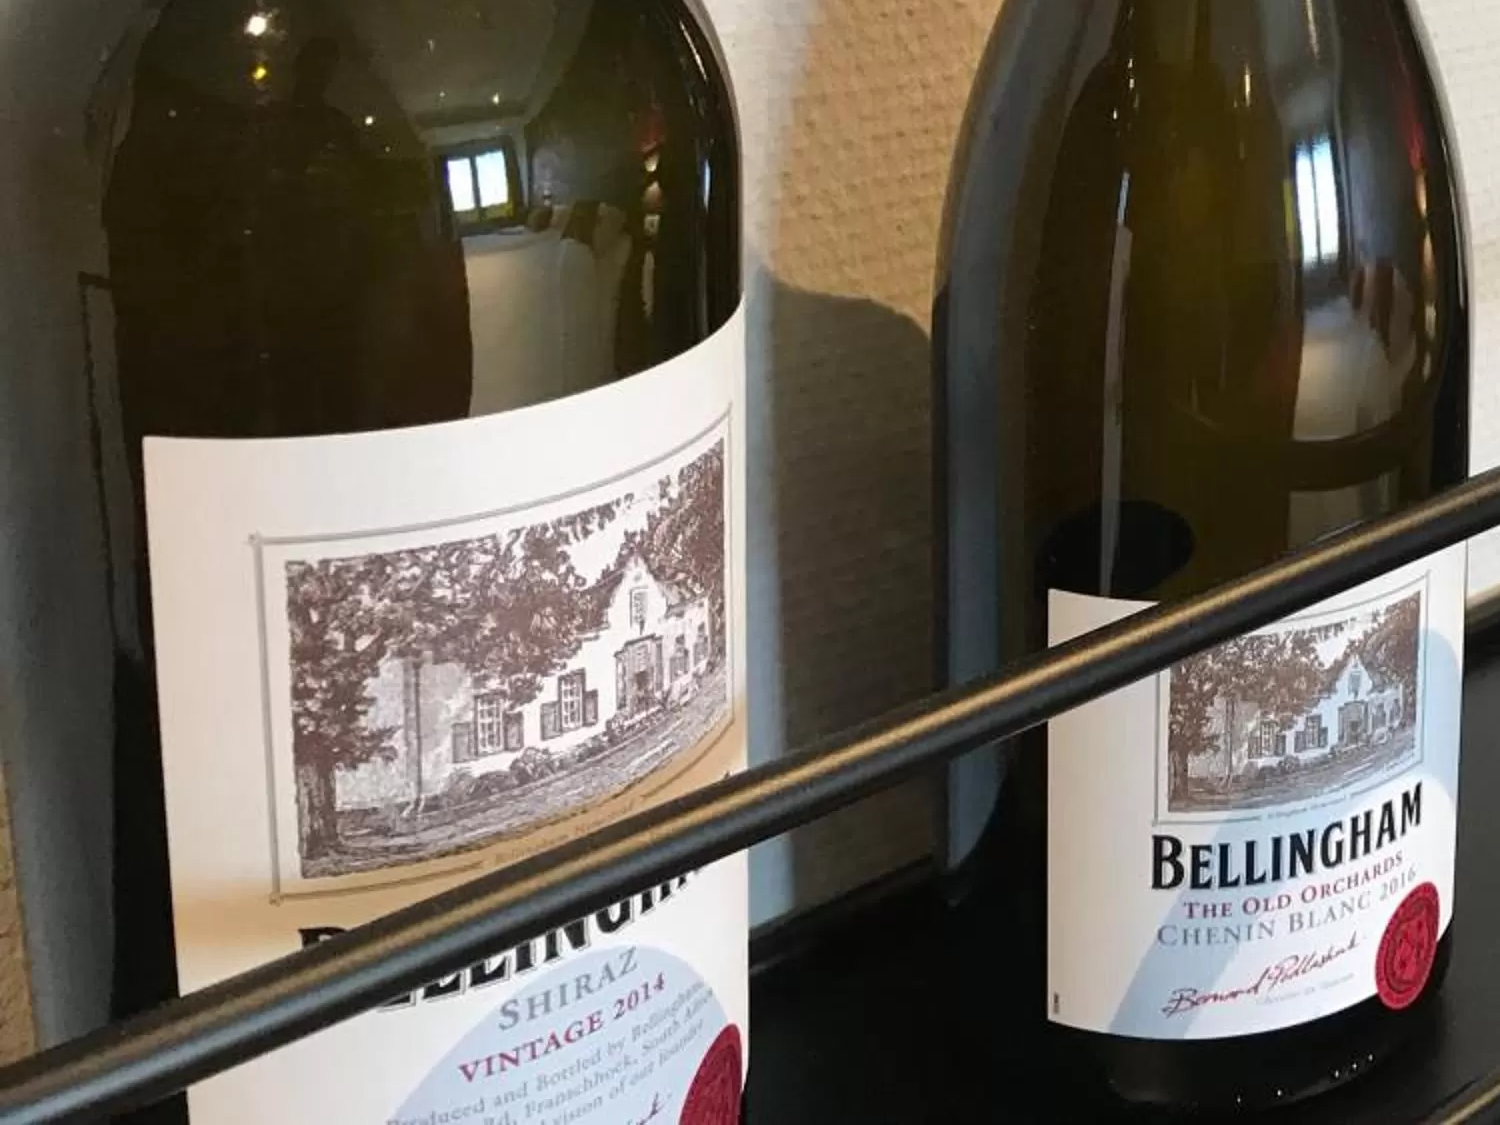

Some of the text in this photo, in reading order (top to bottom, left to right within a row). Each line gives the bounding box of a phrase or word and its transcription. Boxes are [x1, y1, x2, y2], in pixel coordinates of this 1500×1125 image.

[1151, 782, 1422, 890] BELLINGHAM
[1157, 866, 1419, 947] CHENIN BLANC 2016
[1183, 850, 1403, 920] THE OLD ORCHARDS
[458, 971, 665, 1083] VINTAGE 2014
[499, 945, 638, 1031] SHIRAZ
[493, 1081, 528, 1108] and
